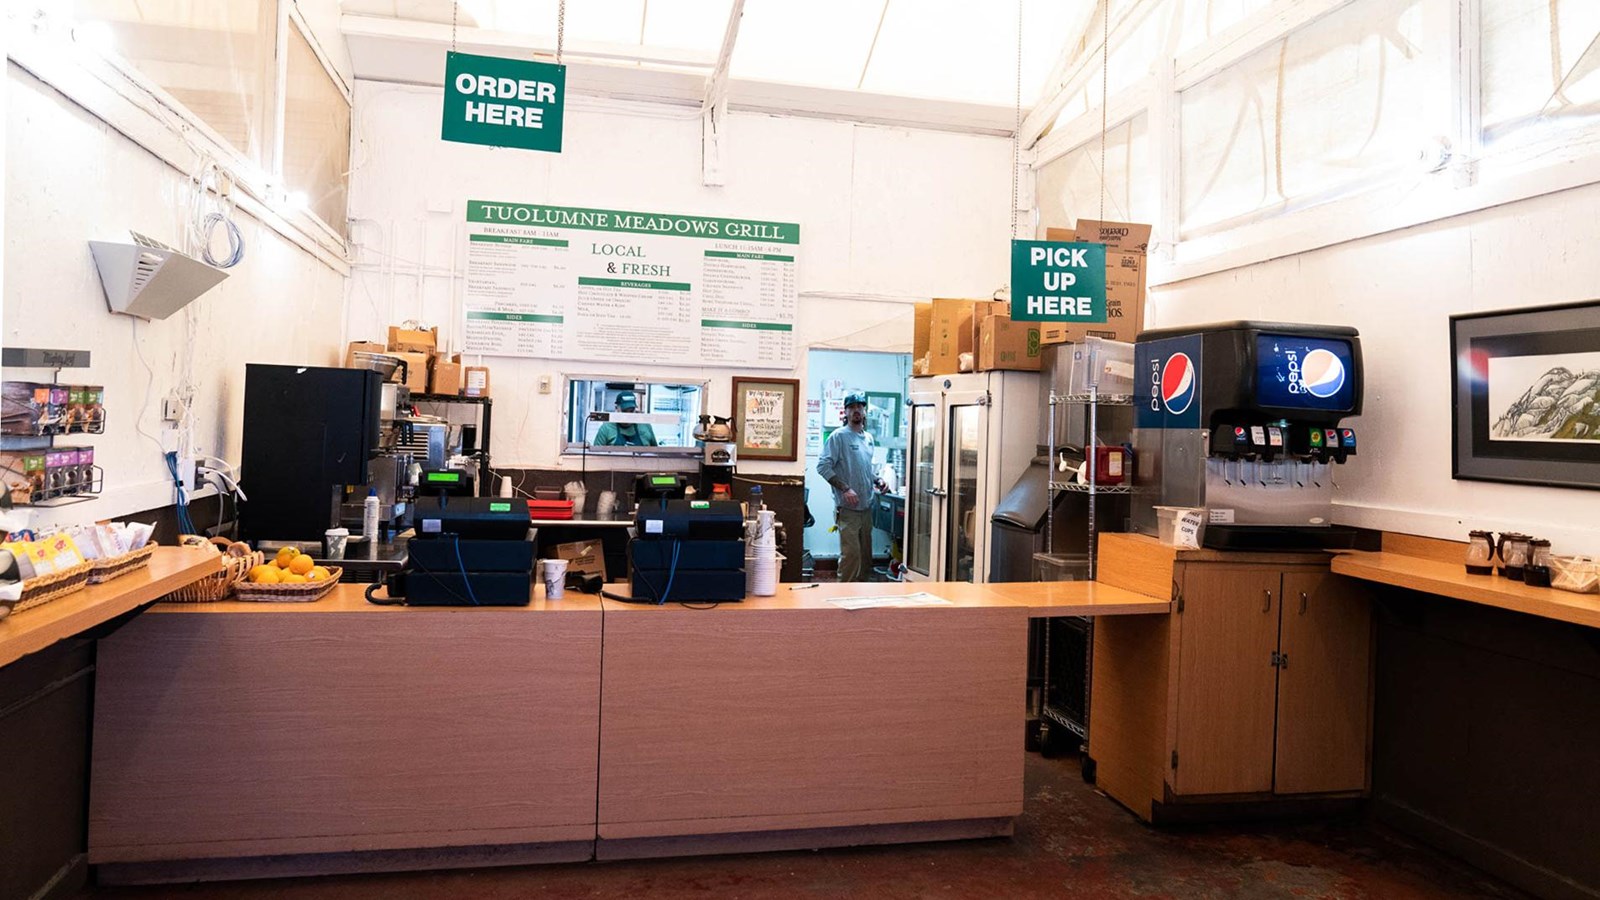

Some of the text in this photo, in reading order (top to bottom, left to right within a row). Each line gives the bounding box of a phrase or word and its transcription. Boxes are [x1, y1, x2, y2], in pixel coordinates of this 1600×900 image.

[456, 73, 556, 104] ORDER
[465, 101, 544, 129] HERE
[481, 204, 785, 240] TUOLUMNE MEADOWS GRILL
[484, 227, 522, 235] BREAKFAST
[1100, 227, 1129, 236] Cheerios
[592, 243, 646, 258] LOCAL
[1030, 248, 1088, 268] PICK
[607, 262, 671, 276] & FRESH
[1043, 272, 1076, 291] UP
[1027, 296, 1092, 316] HERE
[1285, 351, 1300, 394] pepsi
[1151, 358, 1160, 411] pepsi
[1181, 526, 1194, 535] CUPS
[1182, 518, 1199, 526] WATER
